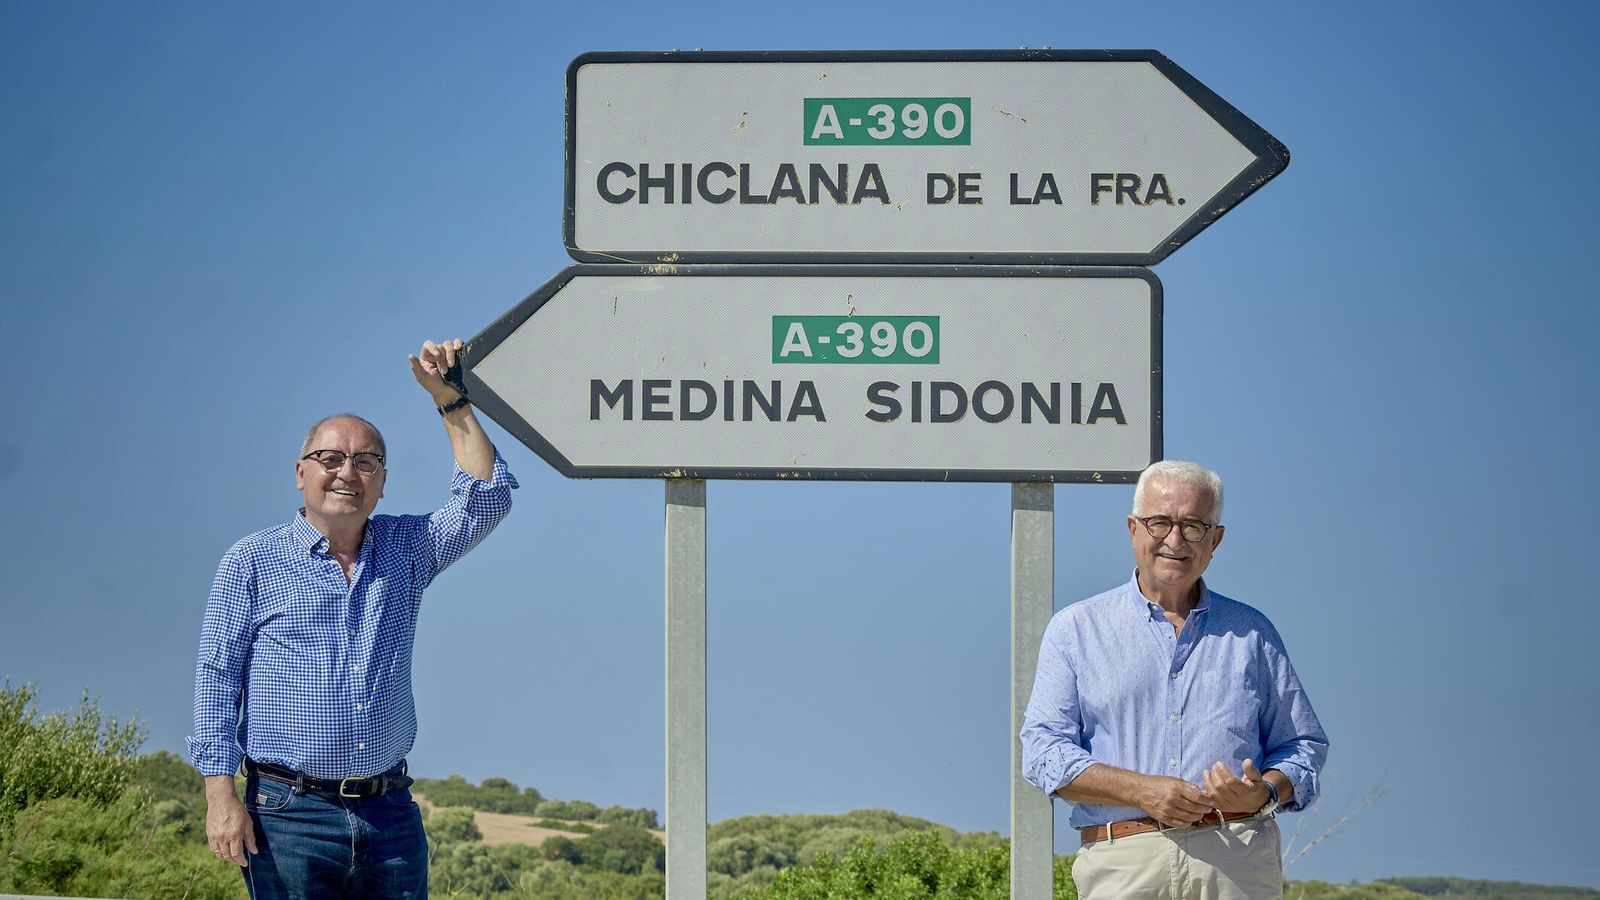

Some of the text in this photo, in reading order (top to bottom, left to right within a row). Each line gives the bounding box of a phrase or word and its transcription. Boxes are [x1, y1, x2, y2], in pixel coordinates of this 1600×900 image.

[811, 103, 965, 140] A-390
[596, 161, 1186, 207] CHICLANA DE LA FRA.
[779, 320, 935, 359] A-390
[589, 378, 1128, 426] MEDINA SIDONIA
